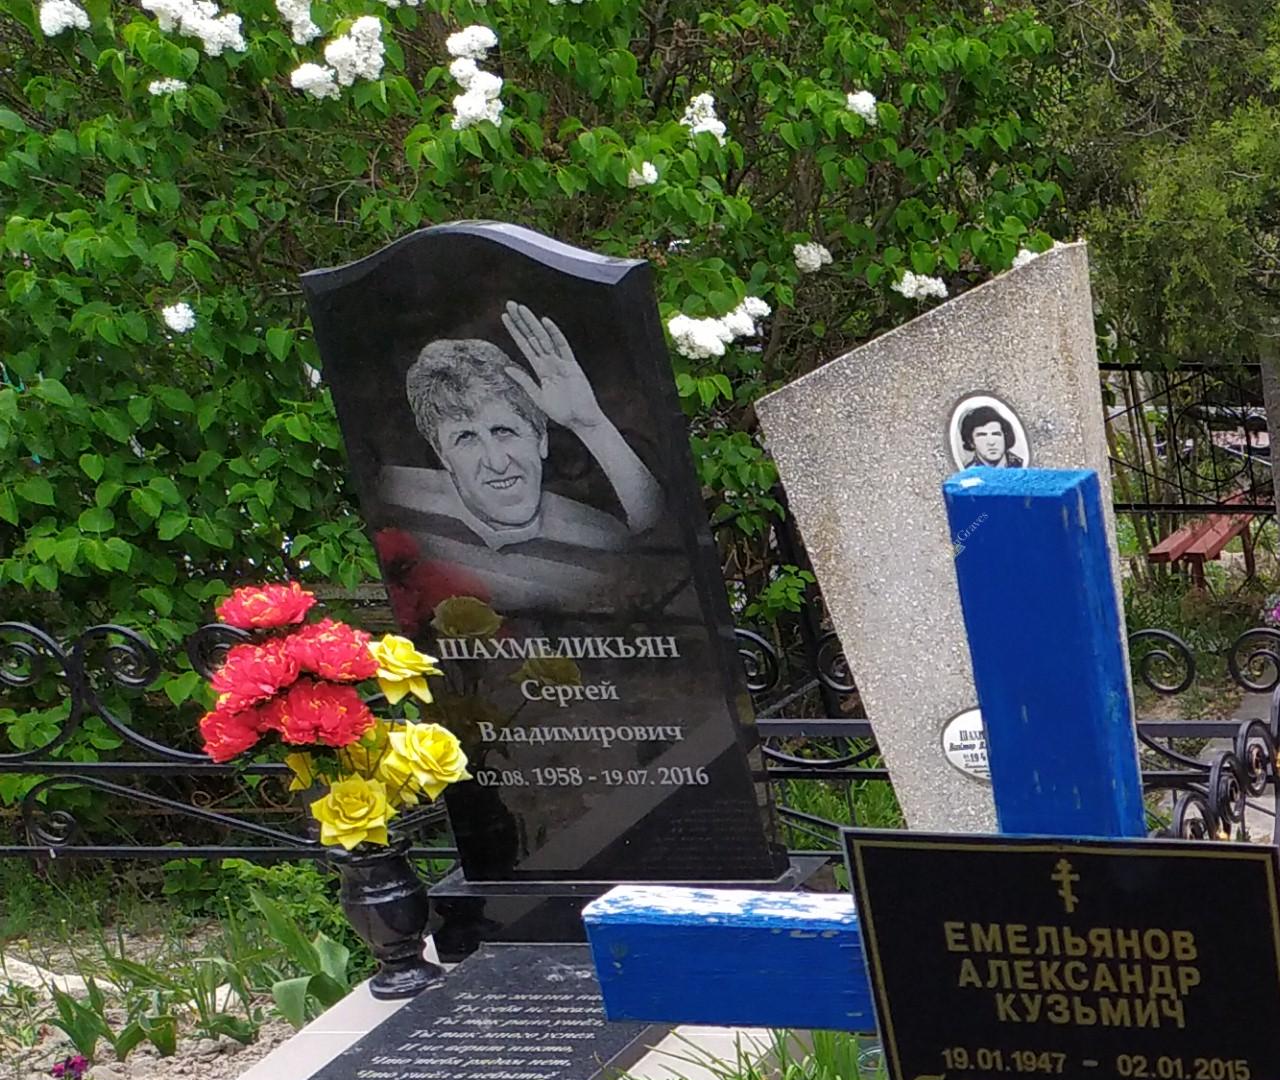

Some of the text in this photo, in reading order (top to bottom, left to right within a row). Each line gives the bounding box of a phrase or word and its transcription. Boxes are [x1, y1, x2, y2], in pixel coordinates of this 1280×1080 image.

[436, 636, 680, 659] ШАХМЕЛИКЬЯН
[521, 679, 619, 707] Сергей
[477, 721, 684, 748] Владимирович
[532, 767, 583, 786] 1958
[658, 766, 710, 786] 2016
[943, 921, 1198, 961] ЕМЕЛЬЯНОВ
[958, 959, 1200, 999] АЛЕКСАНДР
[995, 994, 1185, 1028] КУЗЬМИЧ
[942, 1048, 1066, 1073] 19.01.1947
